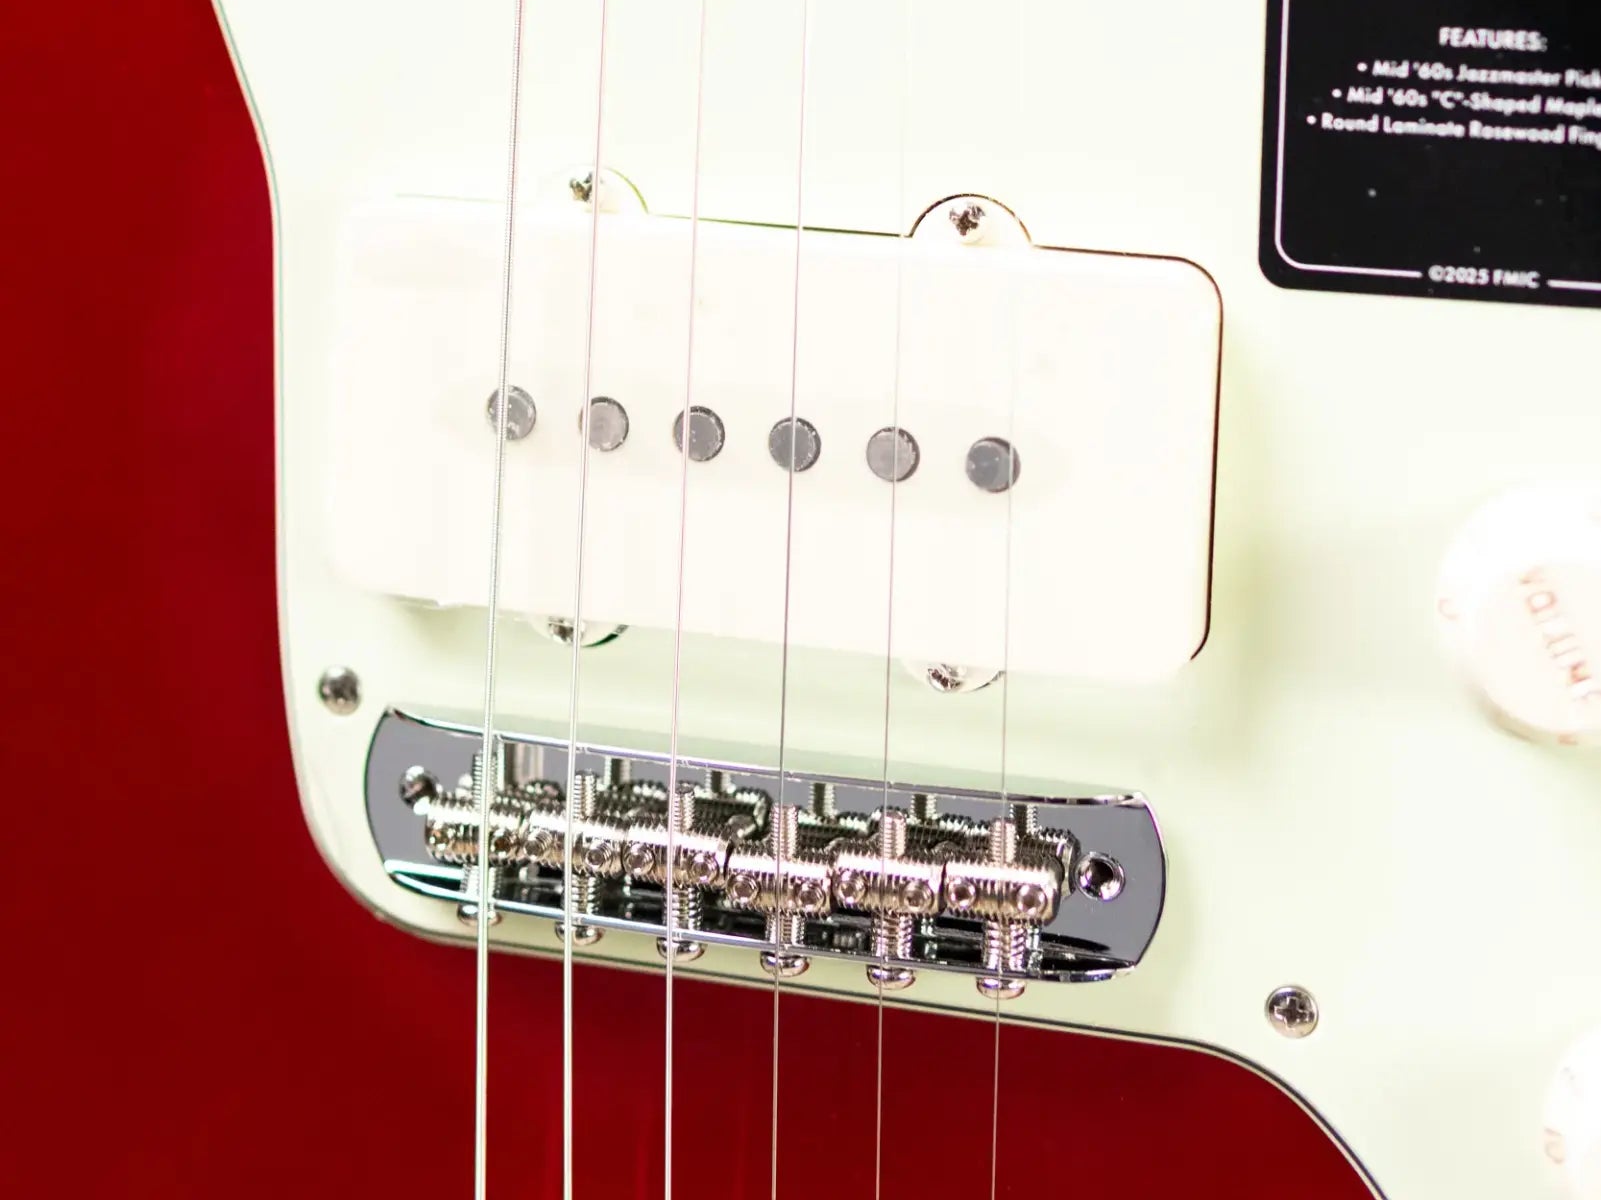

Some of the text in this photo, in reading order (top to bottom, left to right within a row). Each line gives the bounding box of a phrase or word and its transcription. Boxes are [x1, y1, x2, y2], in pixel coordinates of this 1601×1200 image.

[1439, 27, 1546, 51] FEATURES:
[1372, 61, 1409, 78] Mid
[1456, 64, 1561, 86] Jazzmaster
[1347, 87, 1383, 104] Mid
[1322, 112, 1379, 132] Round
[1469, 120, 1565, 143] Rosewood
[1493, 269, 1539, 288] FMIC
